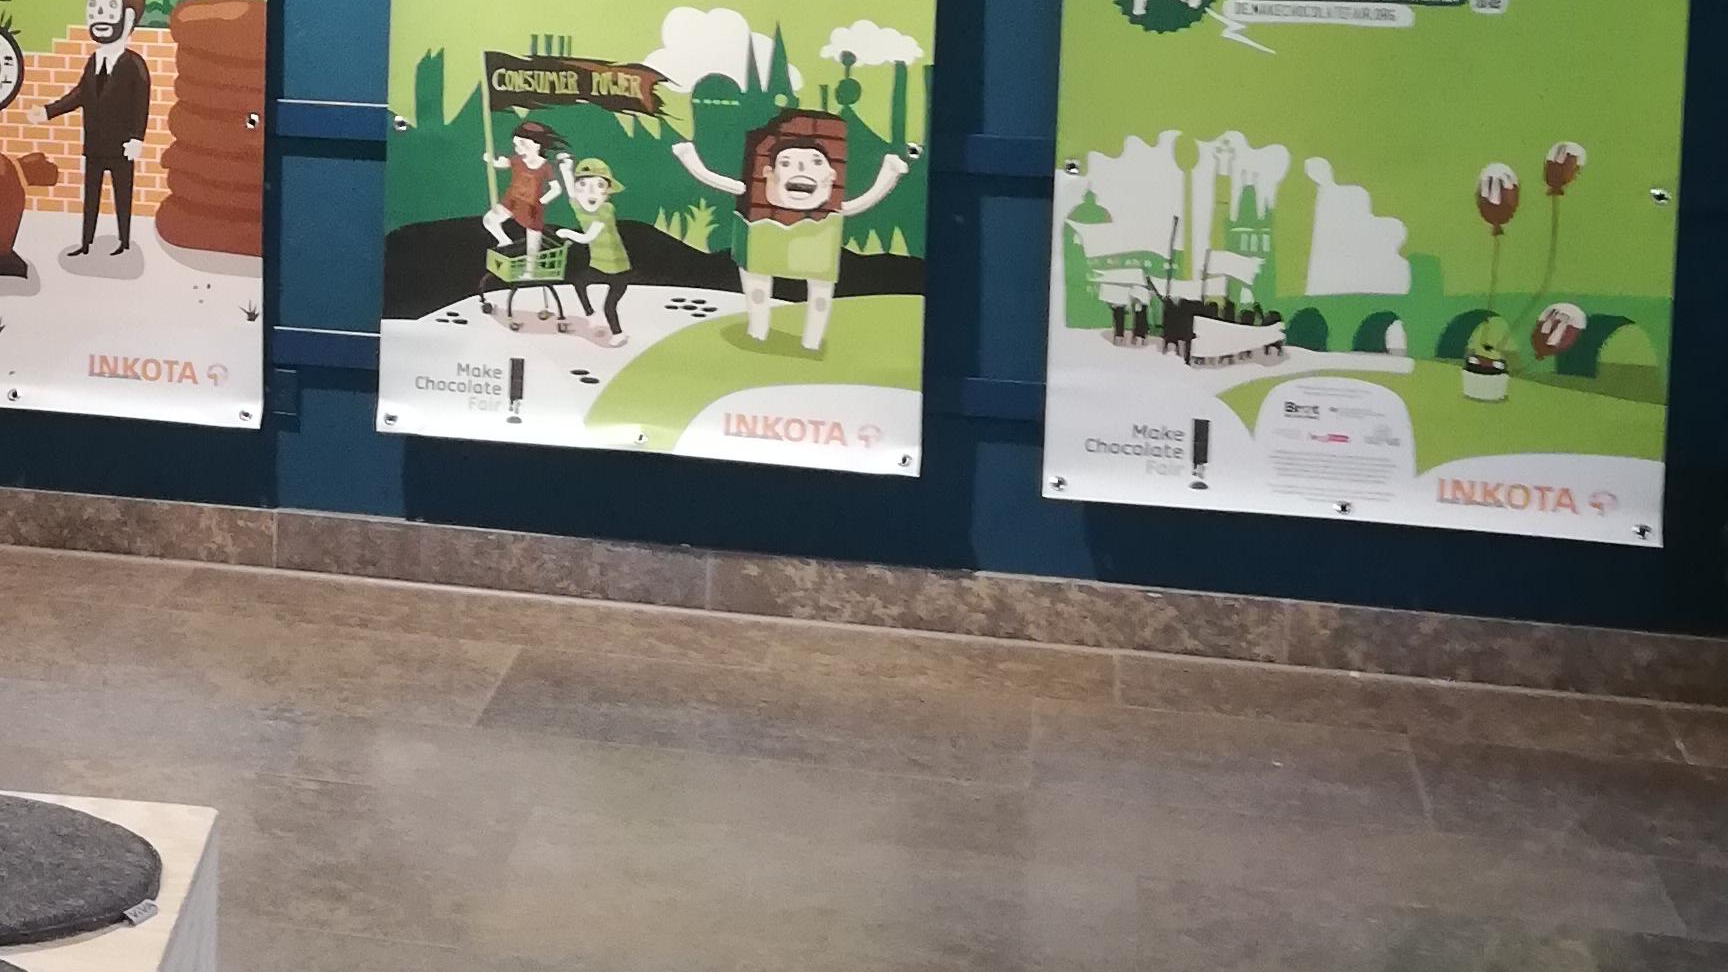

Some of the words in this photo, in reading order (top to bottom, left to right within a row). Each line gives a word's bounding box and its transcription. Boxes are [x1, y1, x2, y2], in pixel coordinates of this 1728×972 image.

[491, 67, 580, 95] CONSUMER
[591, 71, 644, 99] POWER
[89, 353, 201, 386] INKOTA
[457, 362, 503, 381] Make
[415, 375, 503, 397] Chocolate
[468, 396, 502, 413] Fair
[723, 412, 848, 447] INKOTA
[1132, 423, 1185, 443] Make
[1084, 438, 1185, 461] Chocolate
[1146, 459, 1184, 477] Fair
[1437, 476, 1582, 515] INKOTA
